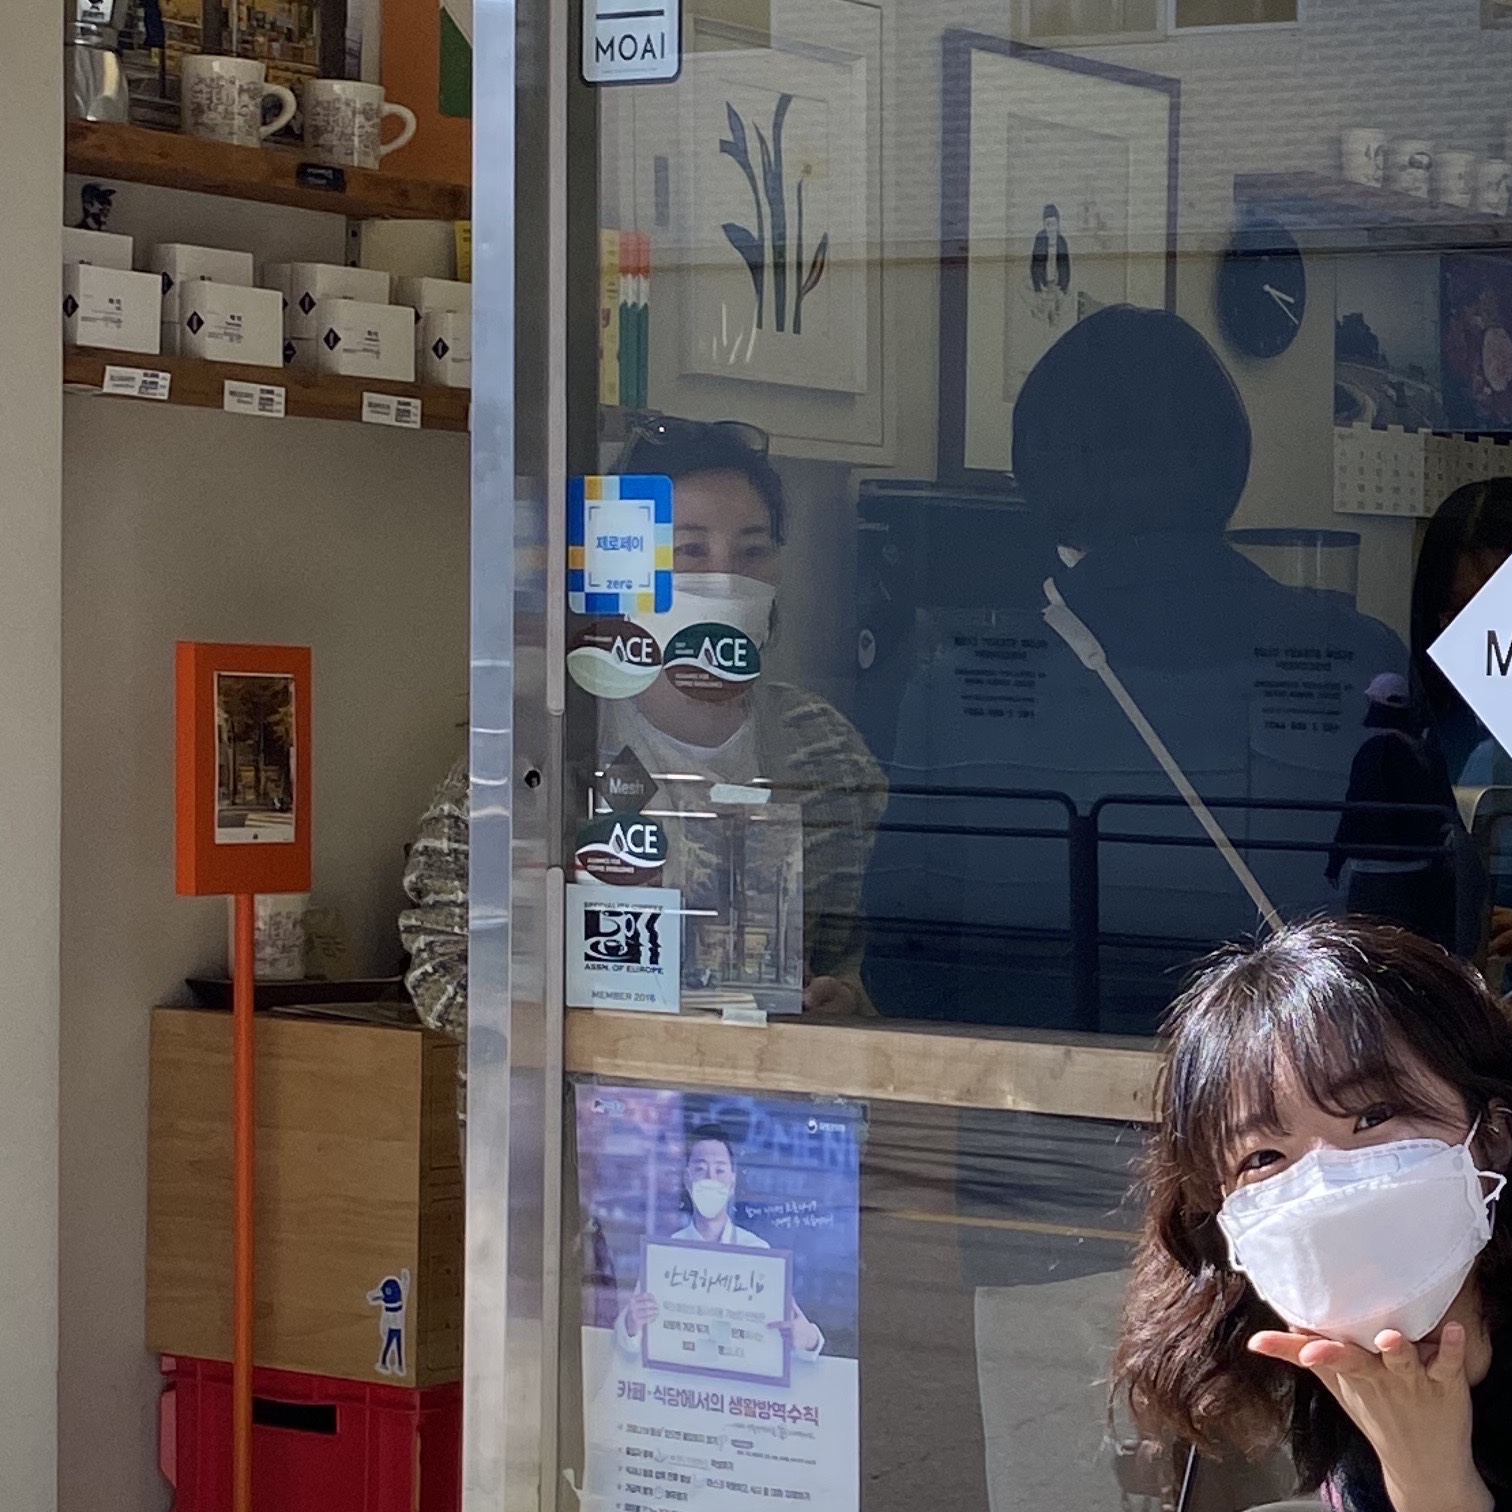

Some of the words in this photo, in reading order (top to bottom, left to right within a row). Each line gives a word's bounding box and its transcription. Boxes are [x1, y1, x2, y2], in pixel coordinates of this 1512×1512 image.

[595, 32, 665, 62] MOAI
[596, 535, 644, 552] 제로페이
[606, 579, 633, 590] zero
[611, 635, 653, 663] ACE
[698, 636, 748, 667] ACE
[609, 777, 645, 795] Mesh
[608, 823, 658, 854] ACE
[664, 1265, 755, 1301] 안녕하세요!
[617, 1380, 725, 1413] 카페·식당에서의
[728, 1395, 819, 1427] 생활방역수칙
